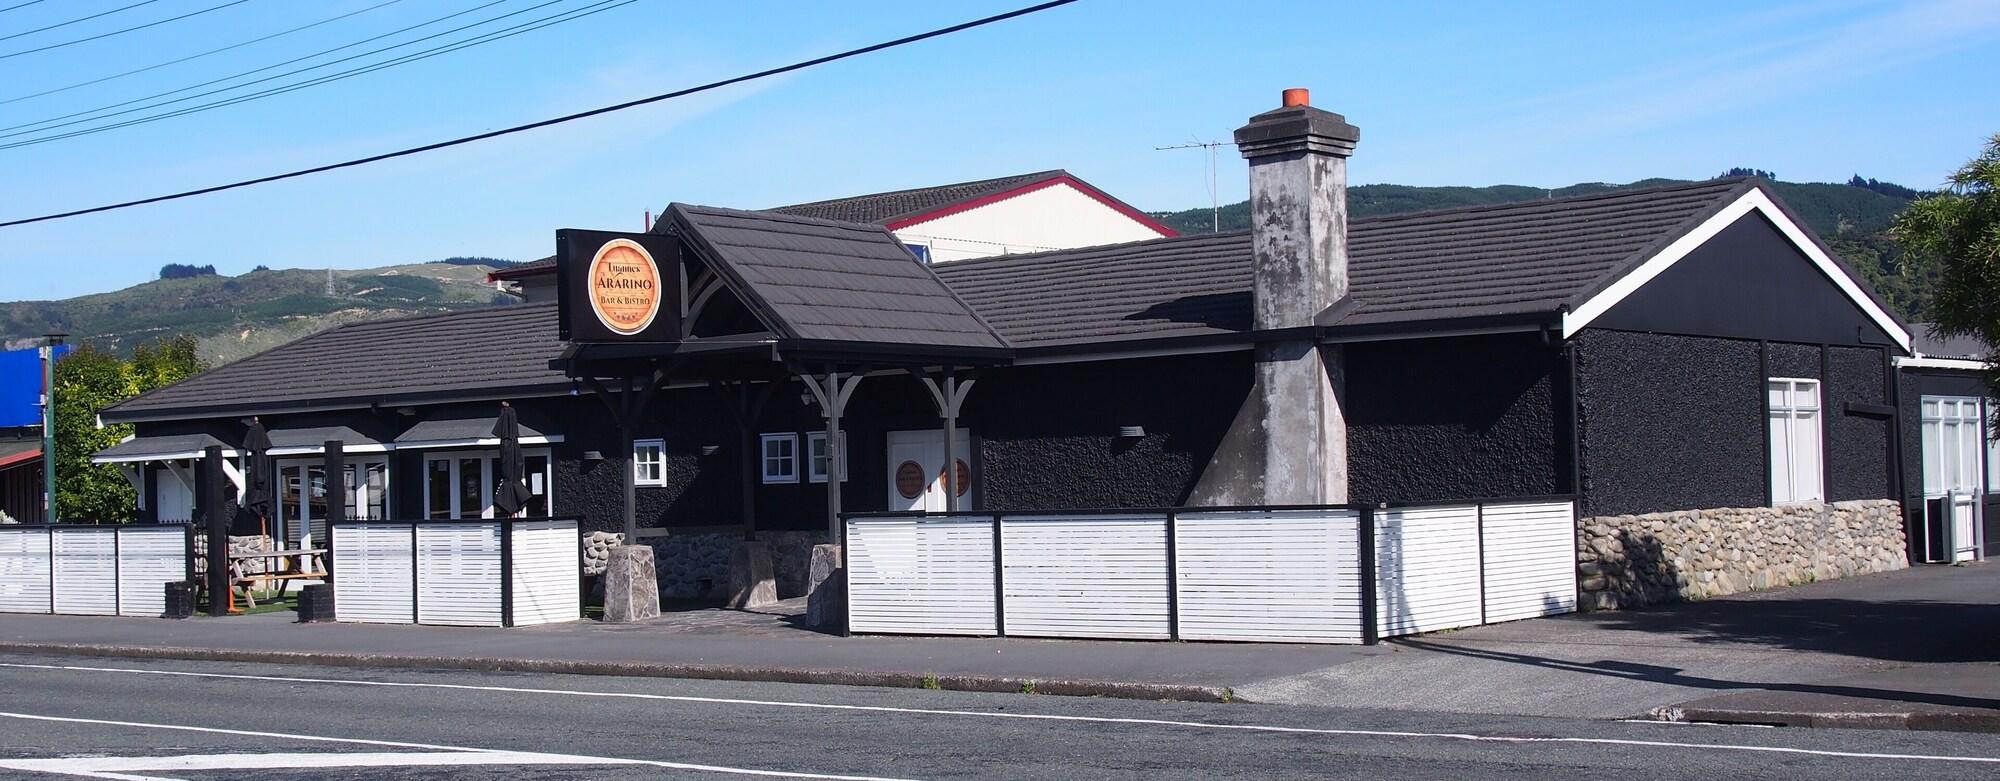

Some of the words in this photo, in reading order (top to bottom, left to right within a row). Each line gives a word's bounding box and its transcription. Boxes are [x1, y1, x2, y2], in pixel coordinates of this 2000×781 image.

[598, 277, 652, 290] ARARINO
[600, 296, 615, 304] BAR
[624, 296, 650, 305] BISTRO
